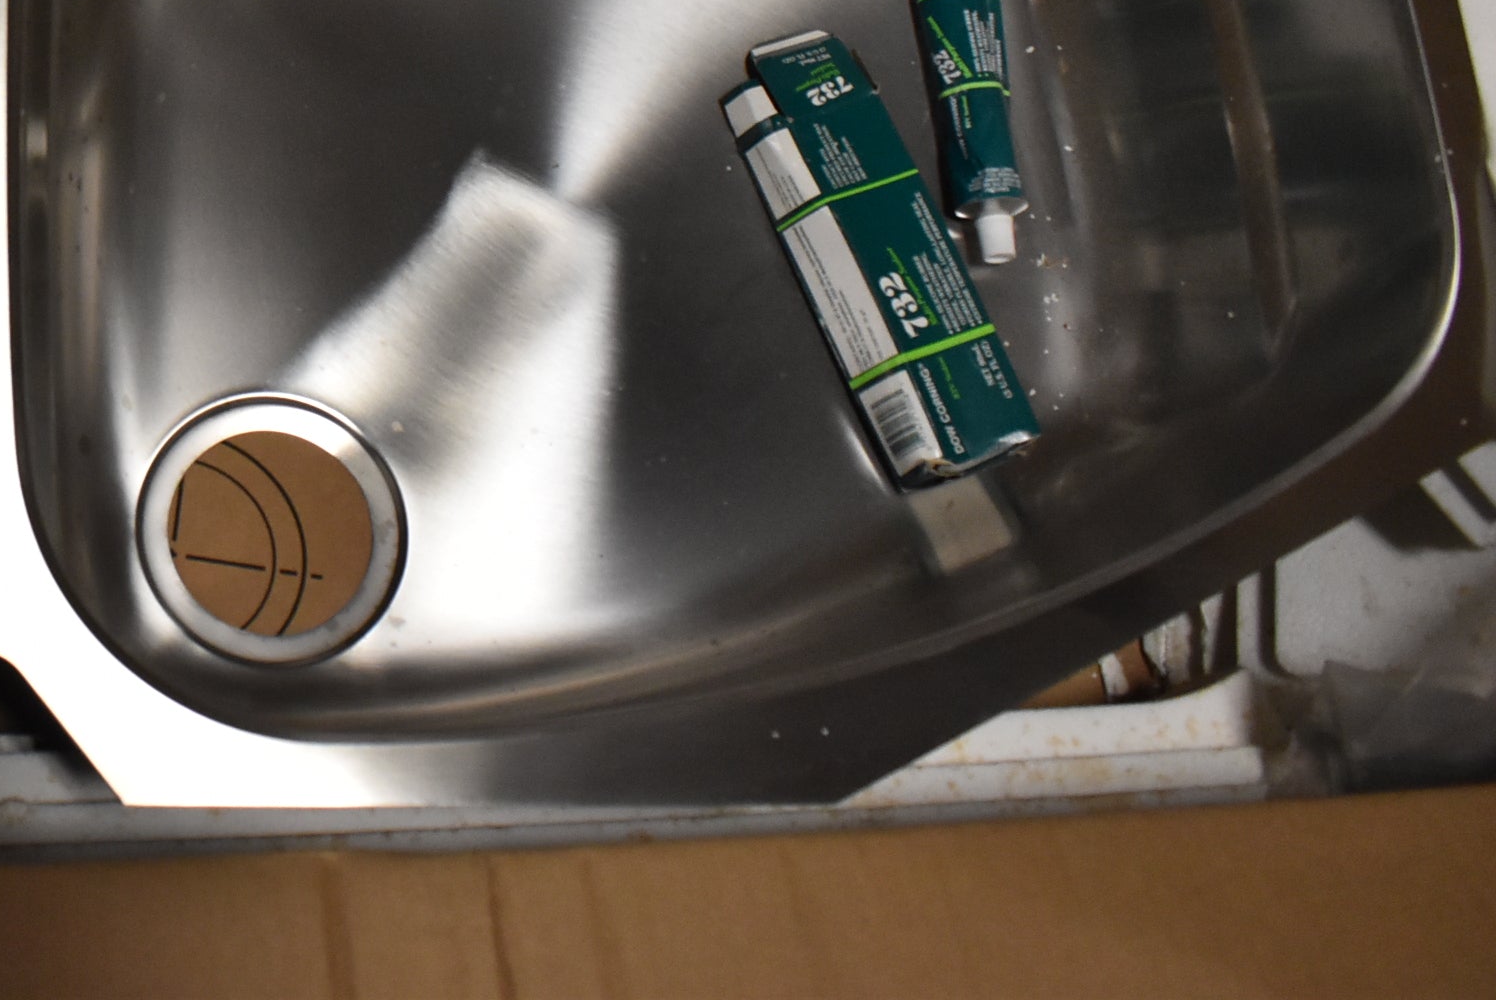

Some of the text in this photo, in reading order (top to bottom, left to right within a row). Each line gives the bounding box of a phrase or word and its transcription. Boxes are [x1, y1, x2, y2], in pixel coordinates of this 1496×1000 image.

[806, 75, 854, 106] 732
[933, 49, 962, 84] 732
[875, 265, 933, 341] 732
[917, 366, 966, 455] DOW CORNING
